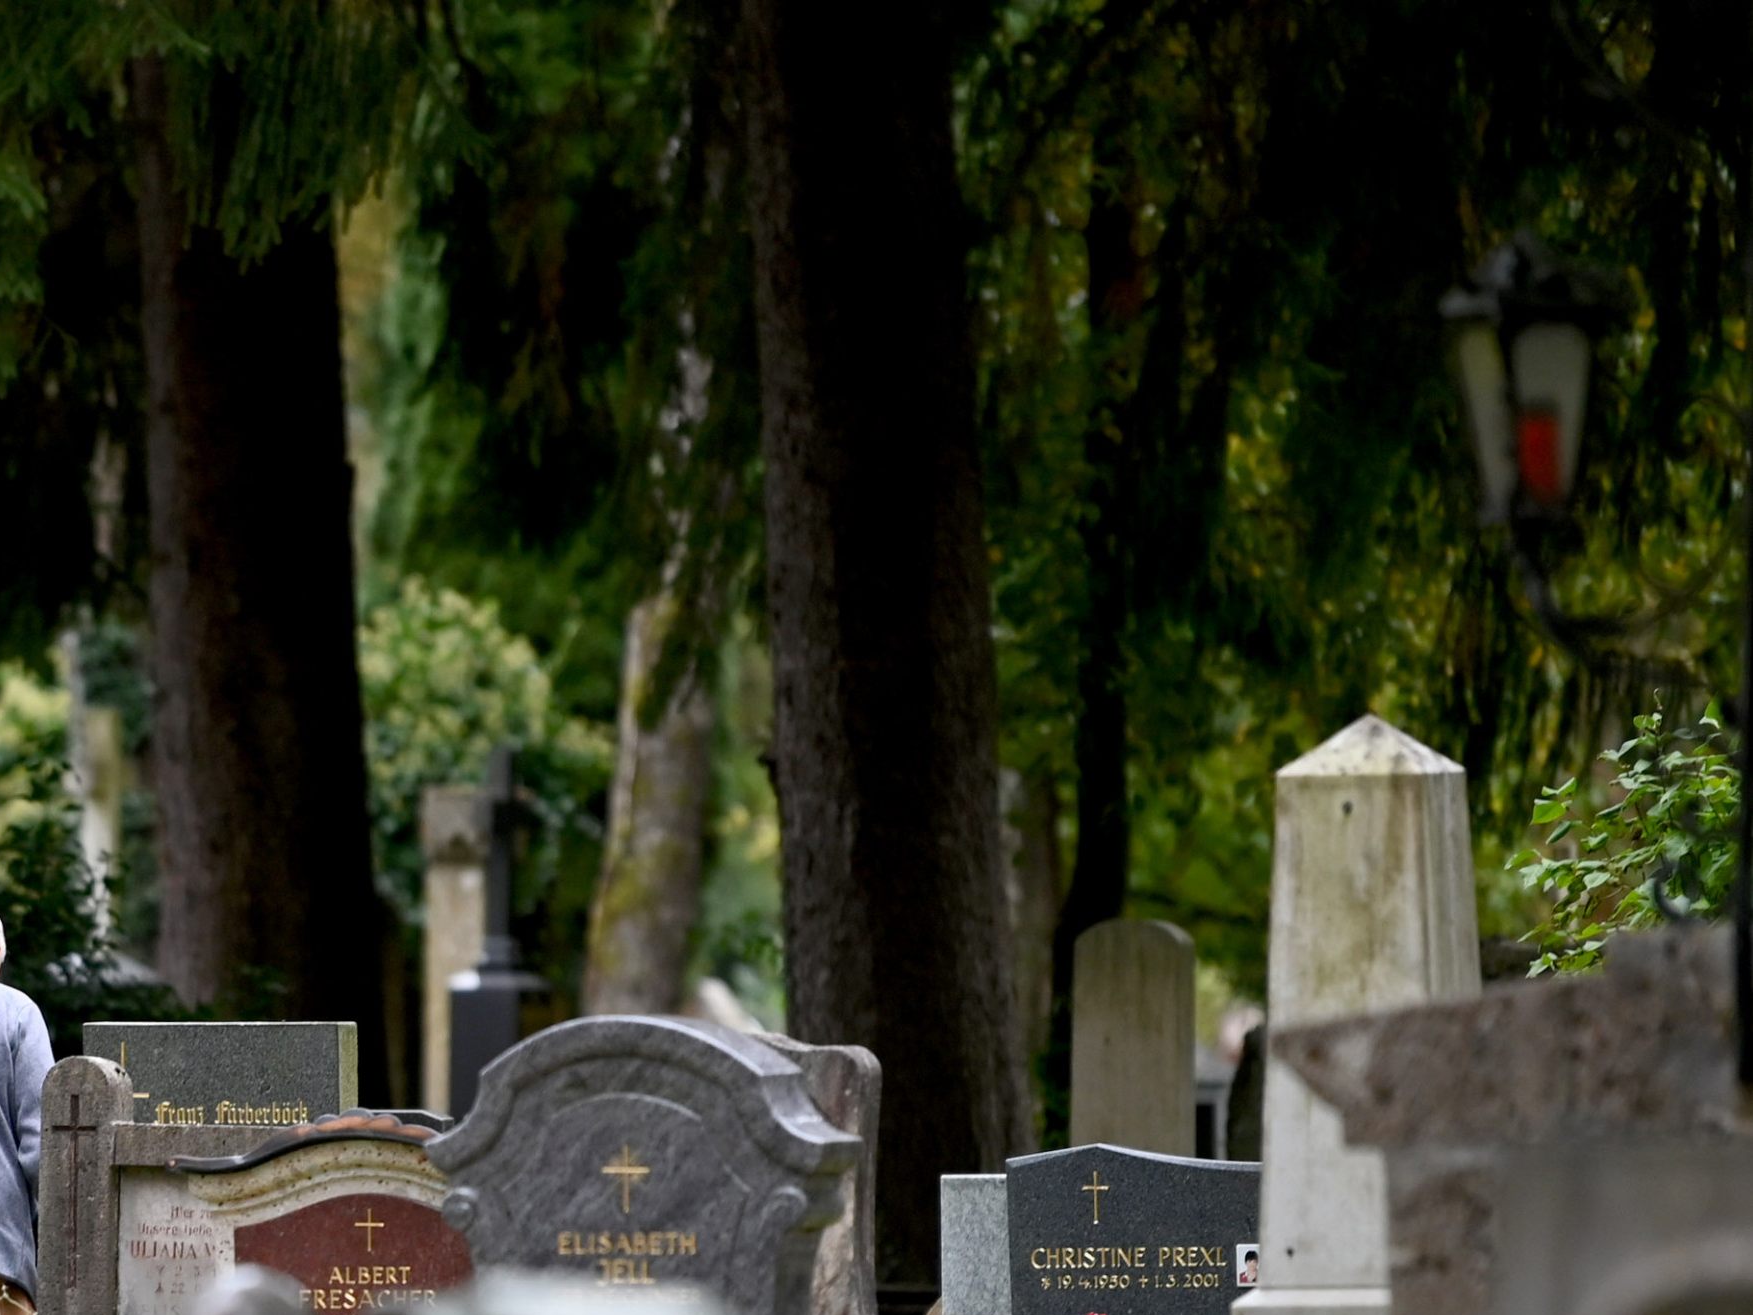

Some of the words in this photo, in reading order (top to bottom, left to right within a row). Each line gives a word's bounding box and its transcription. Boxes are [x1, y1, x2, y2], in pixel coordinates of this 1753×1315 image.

[557, 1231, 700, 1256] ELISABETH
[1030, 1247, 1146, 1269] CHRISTINE
[1157, 1246, 1227, 1268] PREXL
[329, 1266, 412, 1285] ALBERT
